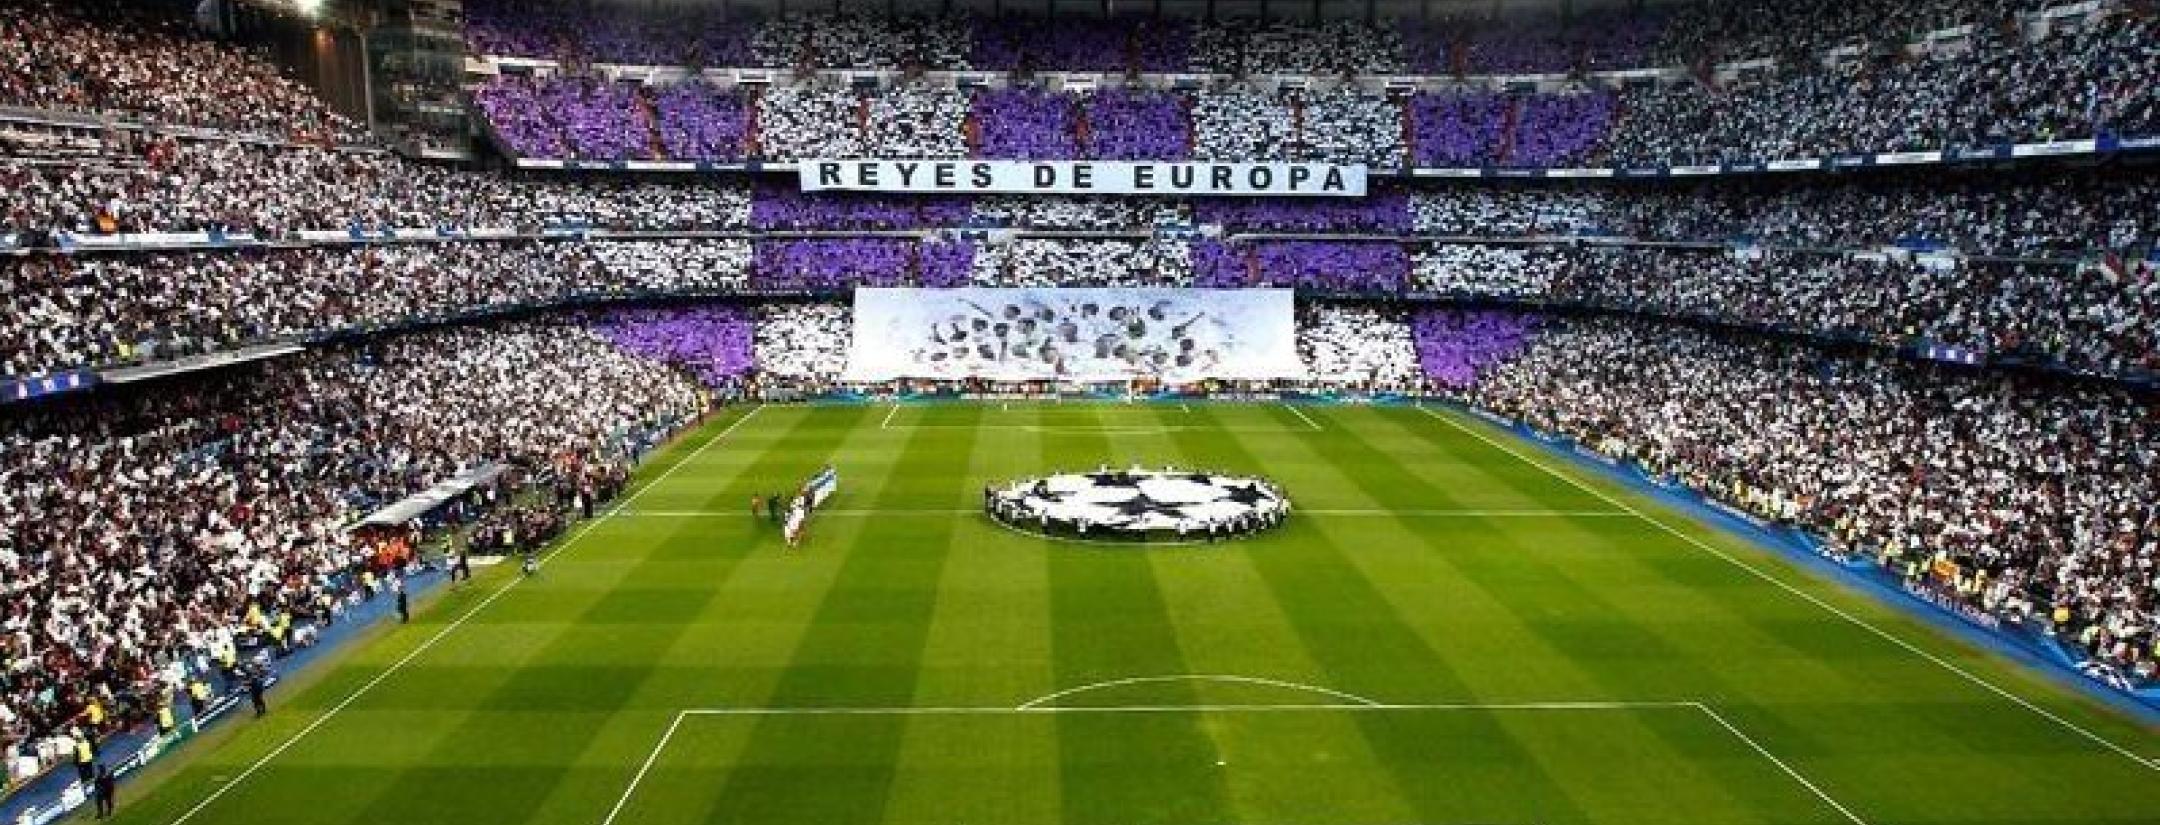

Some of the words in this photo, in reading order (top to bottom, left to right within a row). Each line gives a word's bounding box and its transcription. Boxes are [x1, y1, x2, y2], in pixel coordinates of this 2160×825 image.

[819, 162, 993, 189] REYES
[1033, 164, 1093, 189] DE
[1133, 165, 1347, 191] EUROPA
